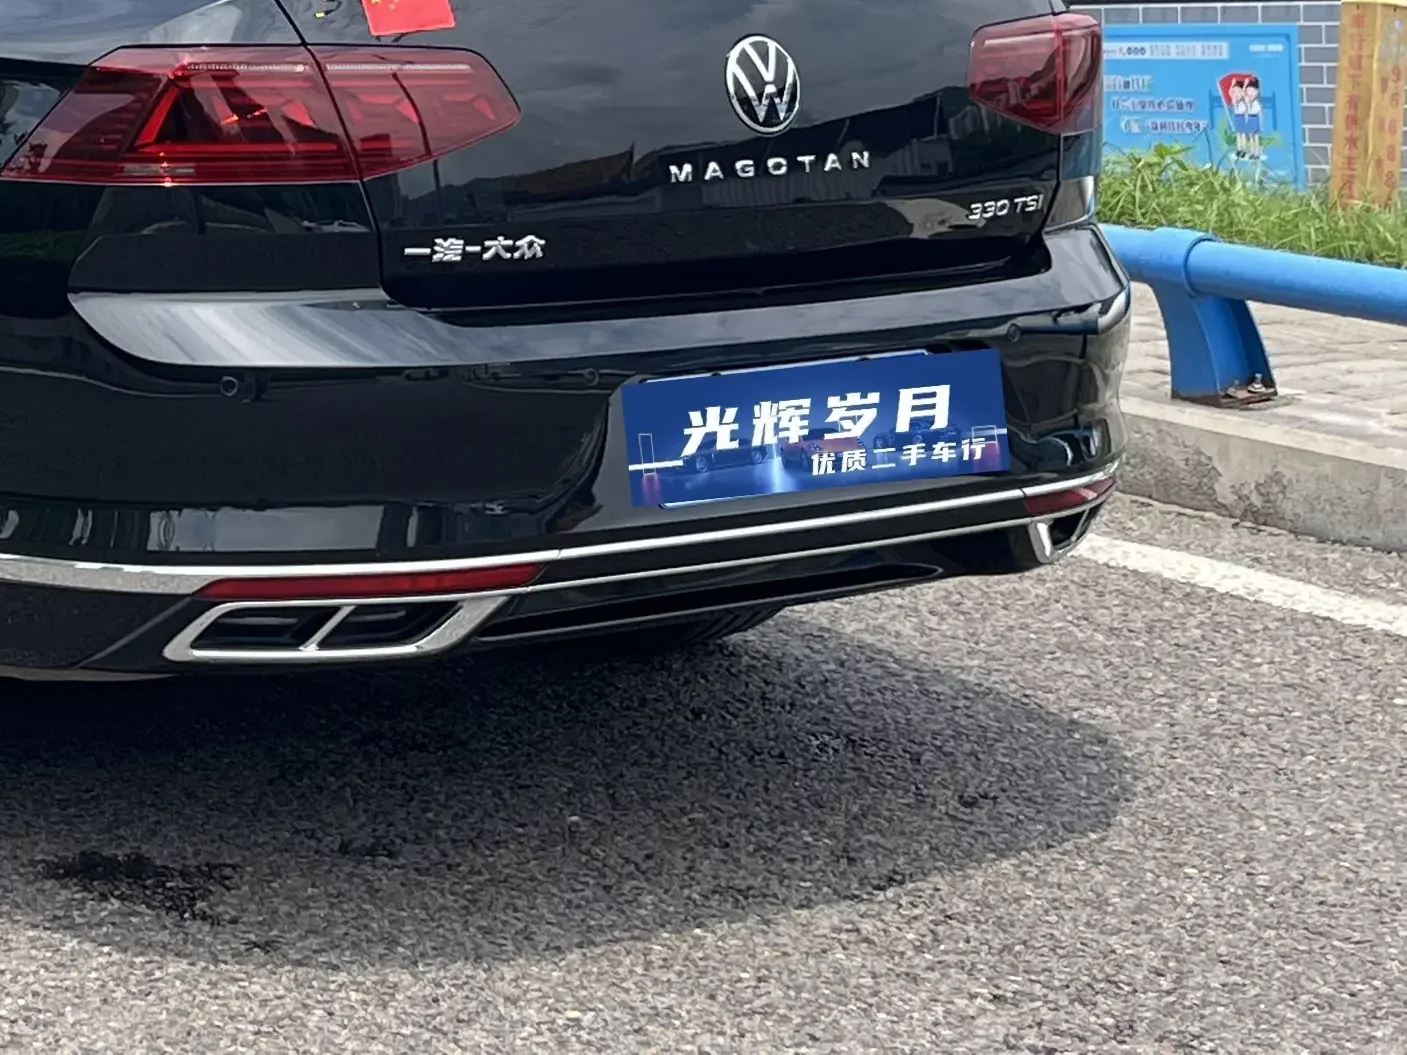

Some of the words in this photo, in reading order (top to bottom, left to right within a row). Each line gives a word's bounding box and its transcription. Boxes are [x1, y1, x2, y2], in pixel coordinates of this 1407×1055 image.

[669, 150, 871, 183] MAGOTAN
[968, 198, 1008, 221] 330
[1016, 193, 1045, 214] TSI
